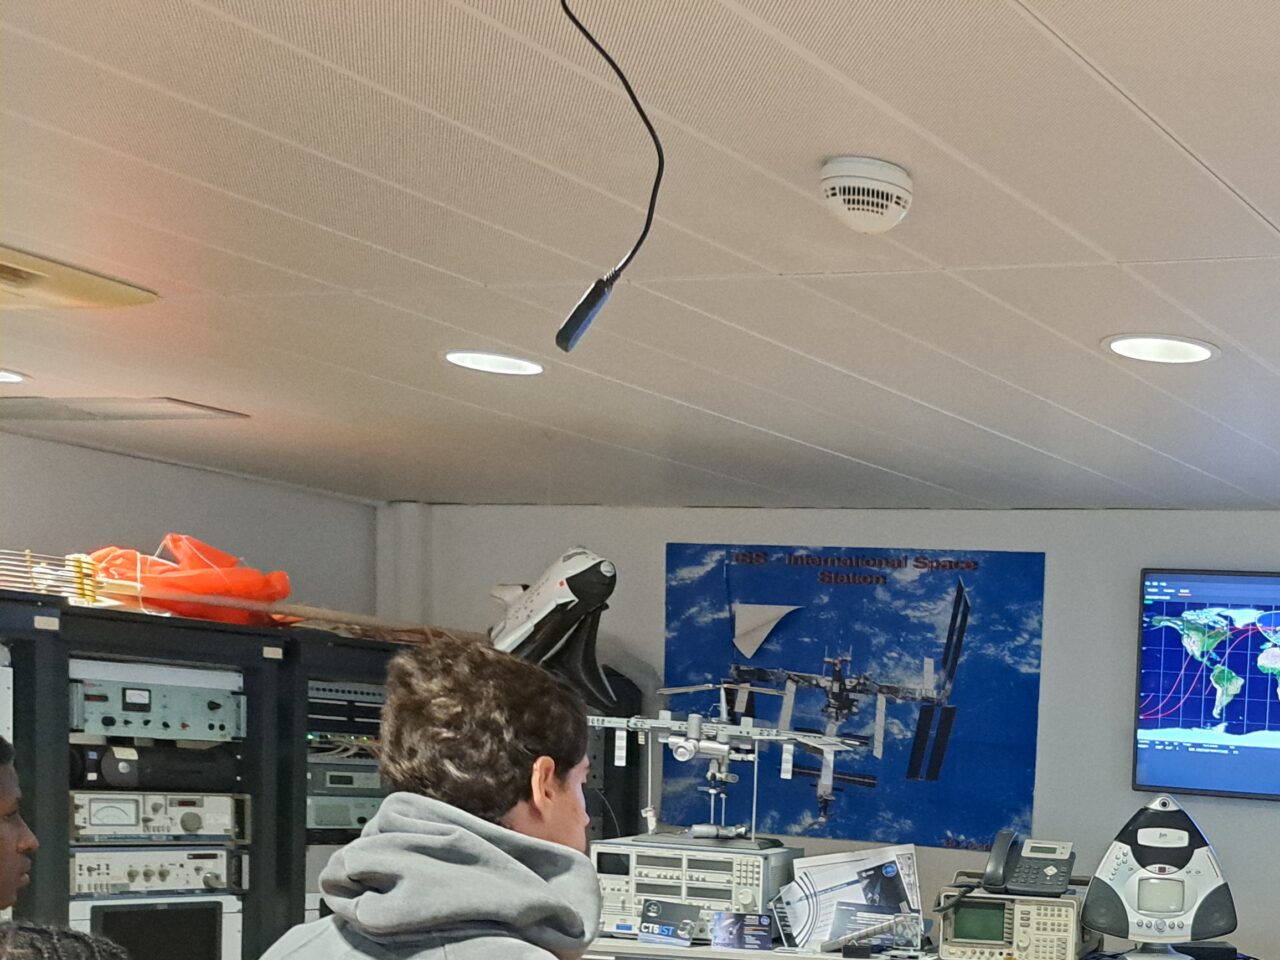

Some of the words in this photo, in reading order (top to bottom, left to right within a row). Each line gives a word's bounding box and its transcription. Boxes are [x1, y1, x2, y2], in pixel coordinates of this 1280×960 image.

[785, 553, 908, 569] International
[912, 557, 978, 575] Space
[818, 571, 888, 585] Station
